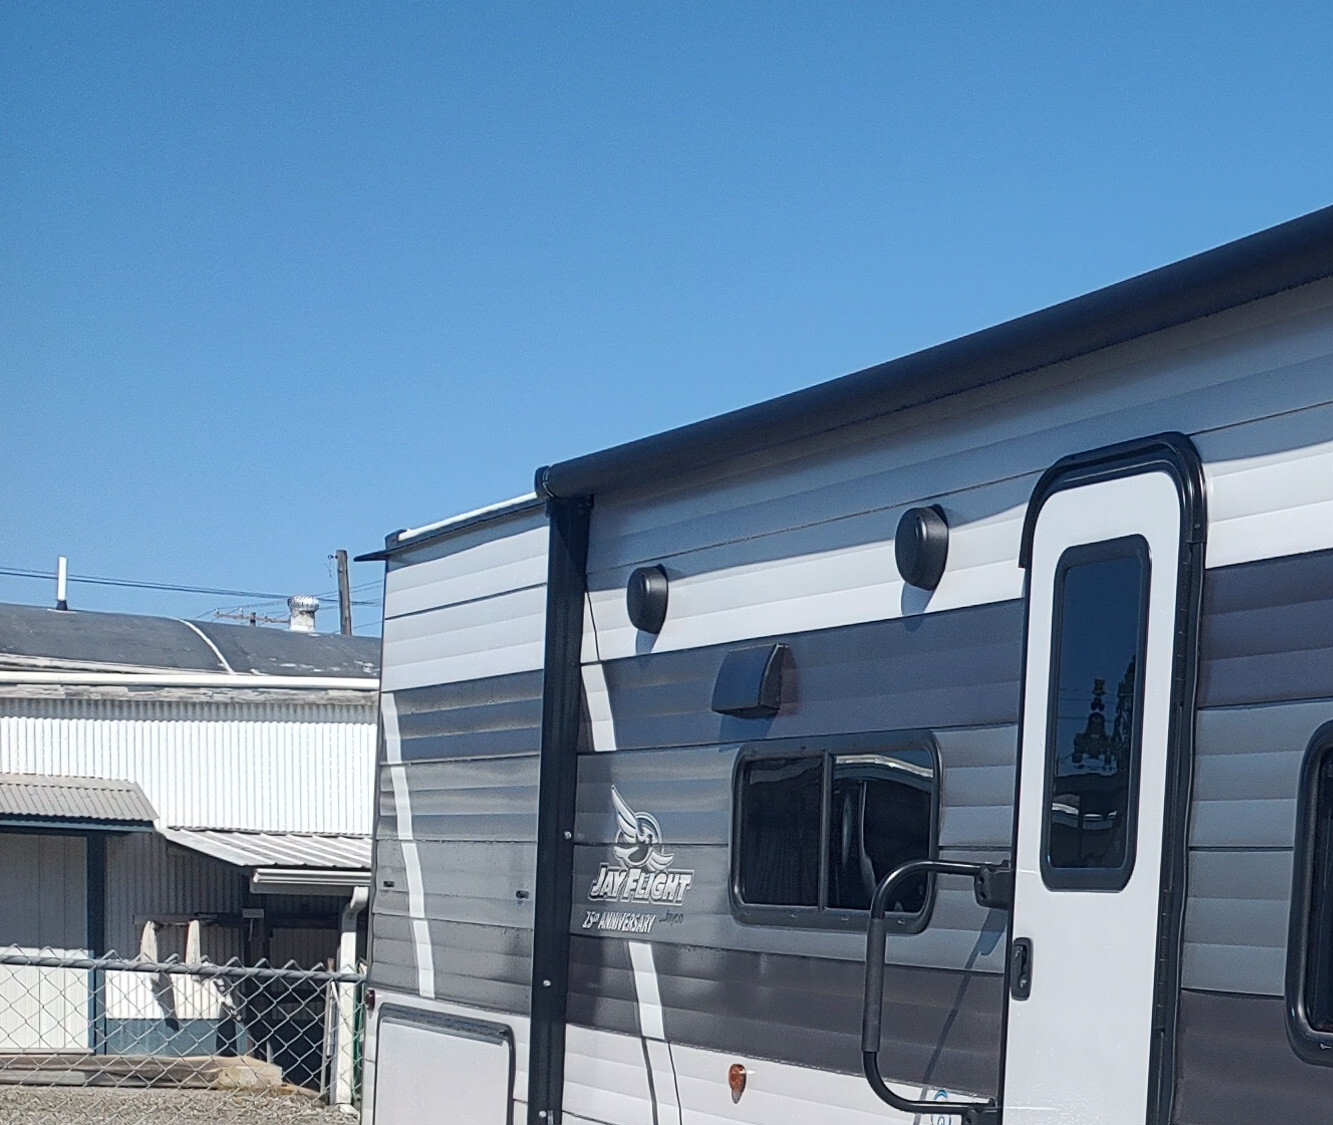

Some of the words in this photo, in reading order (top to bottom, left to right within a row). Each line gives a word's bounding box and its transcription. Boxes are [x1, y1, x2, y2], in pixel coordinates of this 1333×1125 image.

[590, 865, 627, 899] JAY
[622, 868, 692, 902] FLIGHT
[598, 911, 656, 933] ANNIVERSARY
